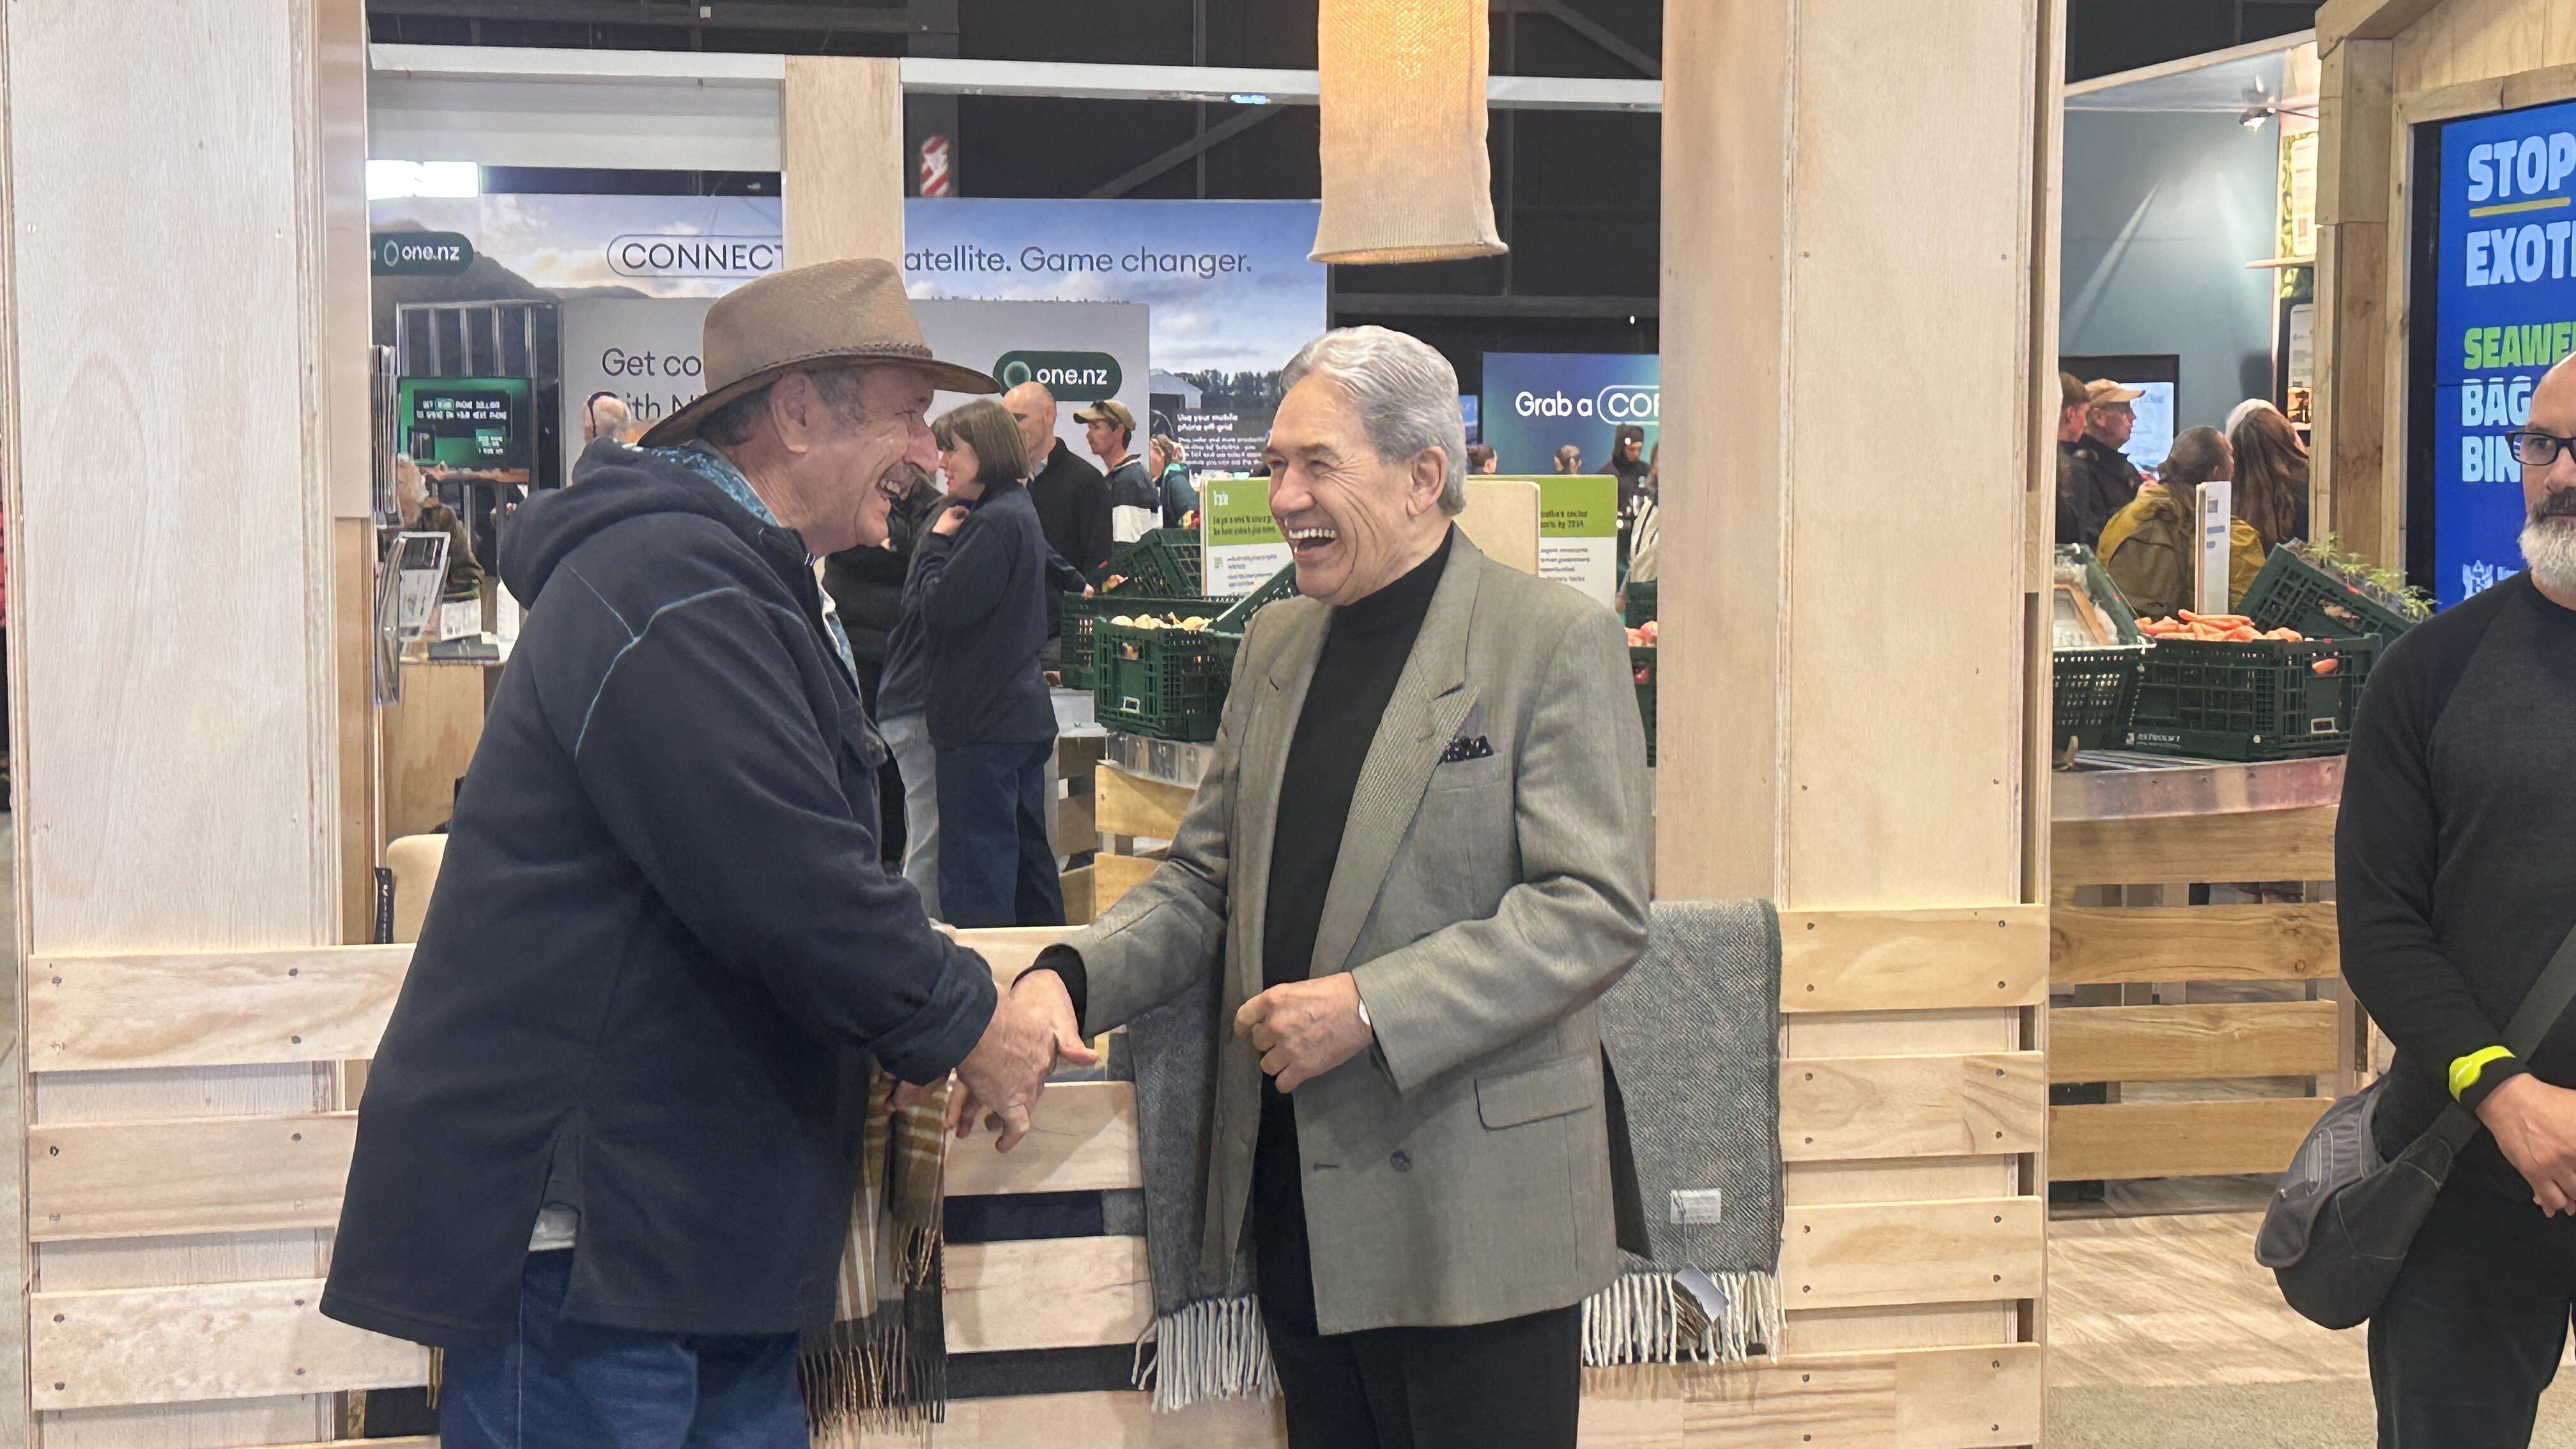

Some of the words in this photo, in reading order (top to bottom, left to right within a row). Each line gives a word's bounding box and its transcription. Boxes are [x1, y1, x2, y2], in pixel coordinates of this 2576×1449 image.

[2468, 132, 2576, 201] STOP
[1020, 245, 1113, 273] Game
[1121, 245, 1253, 280] changer.
[2464, 321, 2576, 370] SEAWE
[602, 347, 656, 377] Get
[1036, 367, 1108, 385] one.nz
[1515, 390, 1572, 417] Grab
[1577, 398, 1593, 417] a
